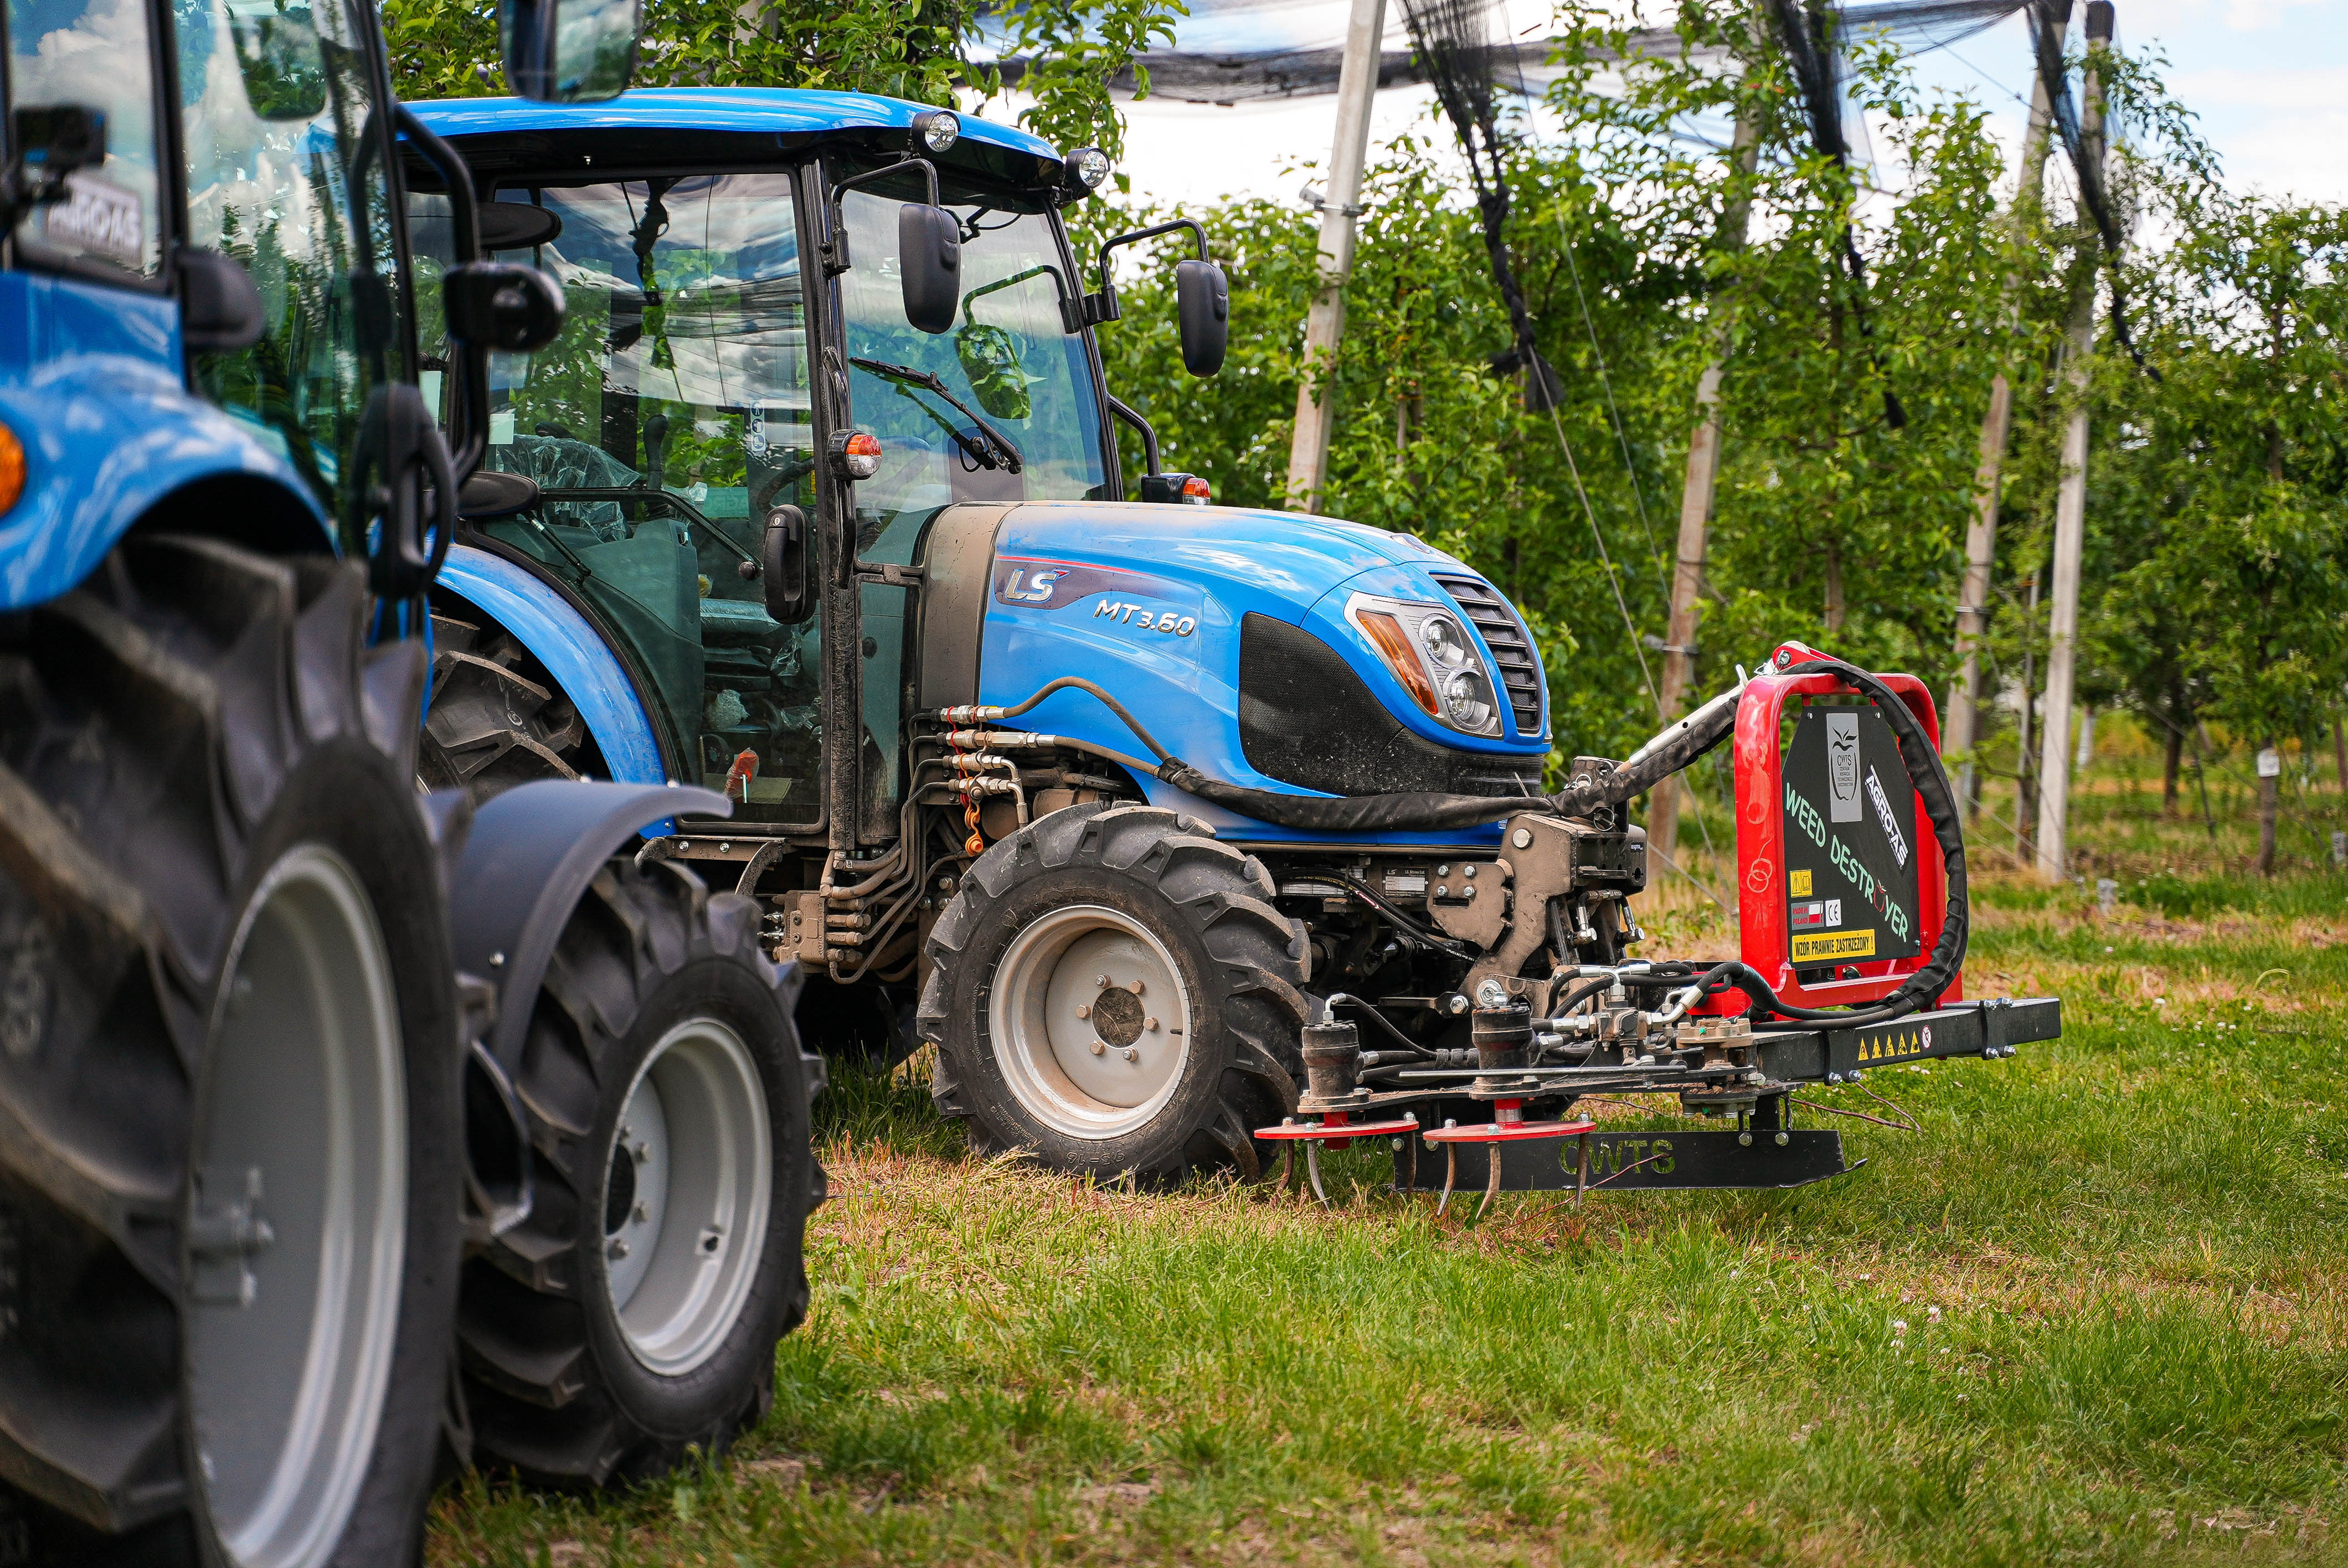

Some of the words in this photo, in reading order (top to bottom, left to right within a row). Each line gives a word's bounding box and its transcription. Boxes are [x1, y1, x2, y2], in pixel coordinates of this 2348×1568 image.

[1005, 569, 1058, 602] LS
[1093, 599, 1196, 637] MT3.60
[1837, 754, 1852, 766] CWTS
[1786, 782, 1826, 848] WEED
[1866, 775, 1907, 866] AGRO-AS
[1795, 937, 1810, 957] WZÓR
[1811, 939, 1835, 955] PRAWNIE
[1836, 933, 1869, 953] ZASTRZEŻONY
[1558, 1139, 1675, 1174] CWTS
